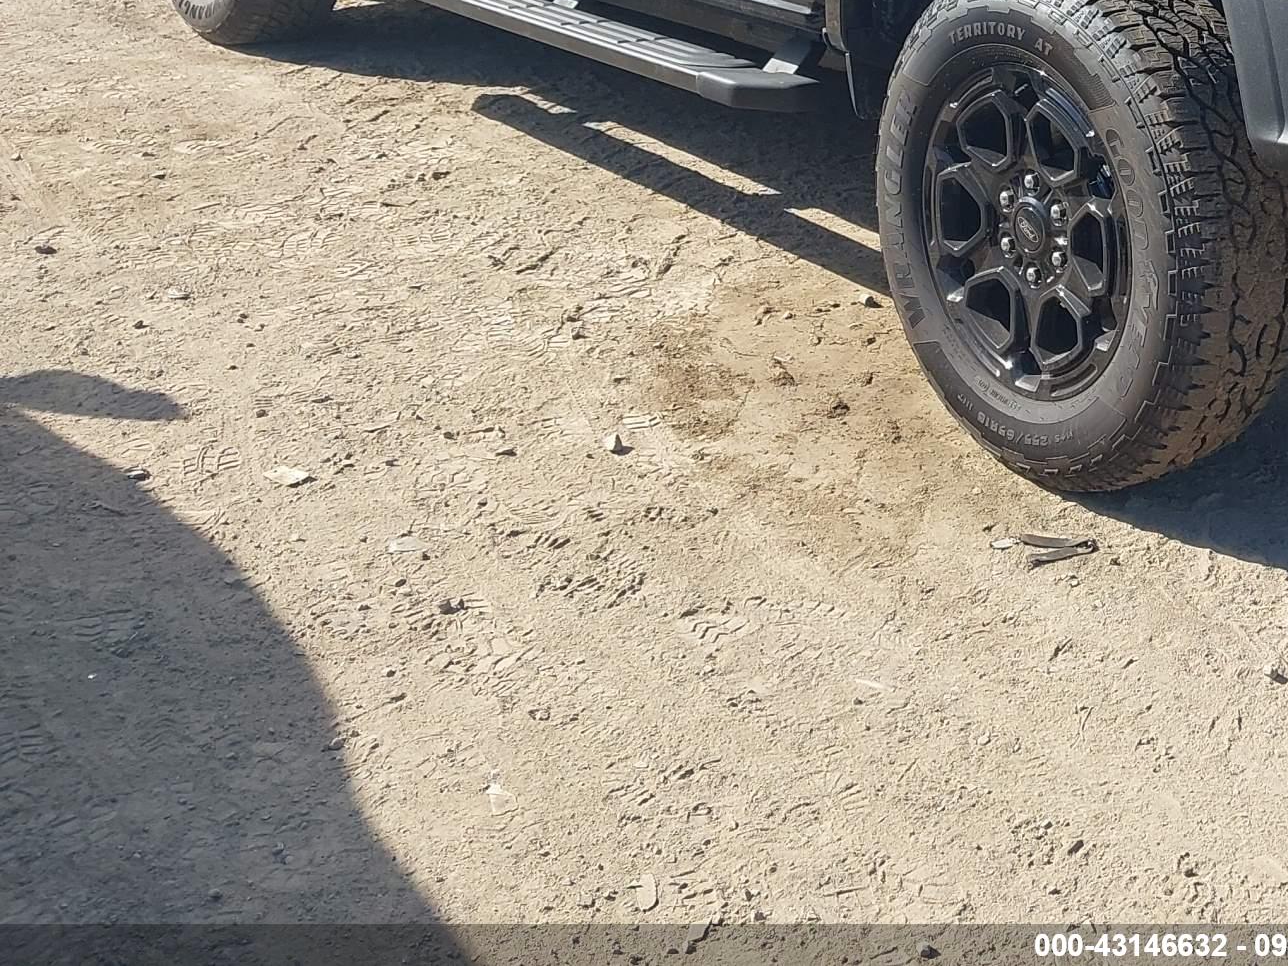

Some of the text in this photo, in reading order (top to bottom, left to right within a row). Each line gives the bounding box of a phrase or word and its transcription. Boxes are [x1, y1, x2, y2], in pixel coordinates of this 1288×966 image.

[947, 21, 1027, 45] TERRITORY
[1033, 37, 1054, 56] AT
[883, 89, 926, 330] WRANGLER
